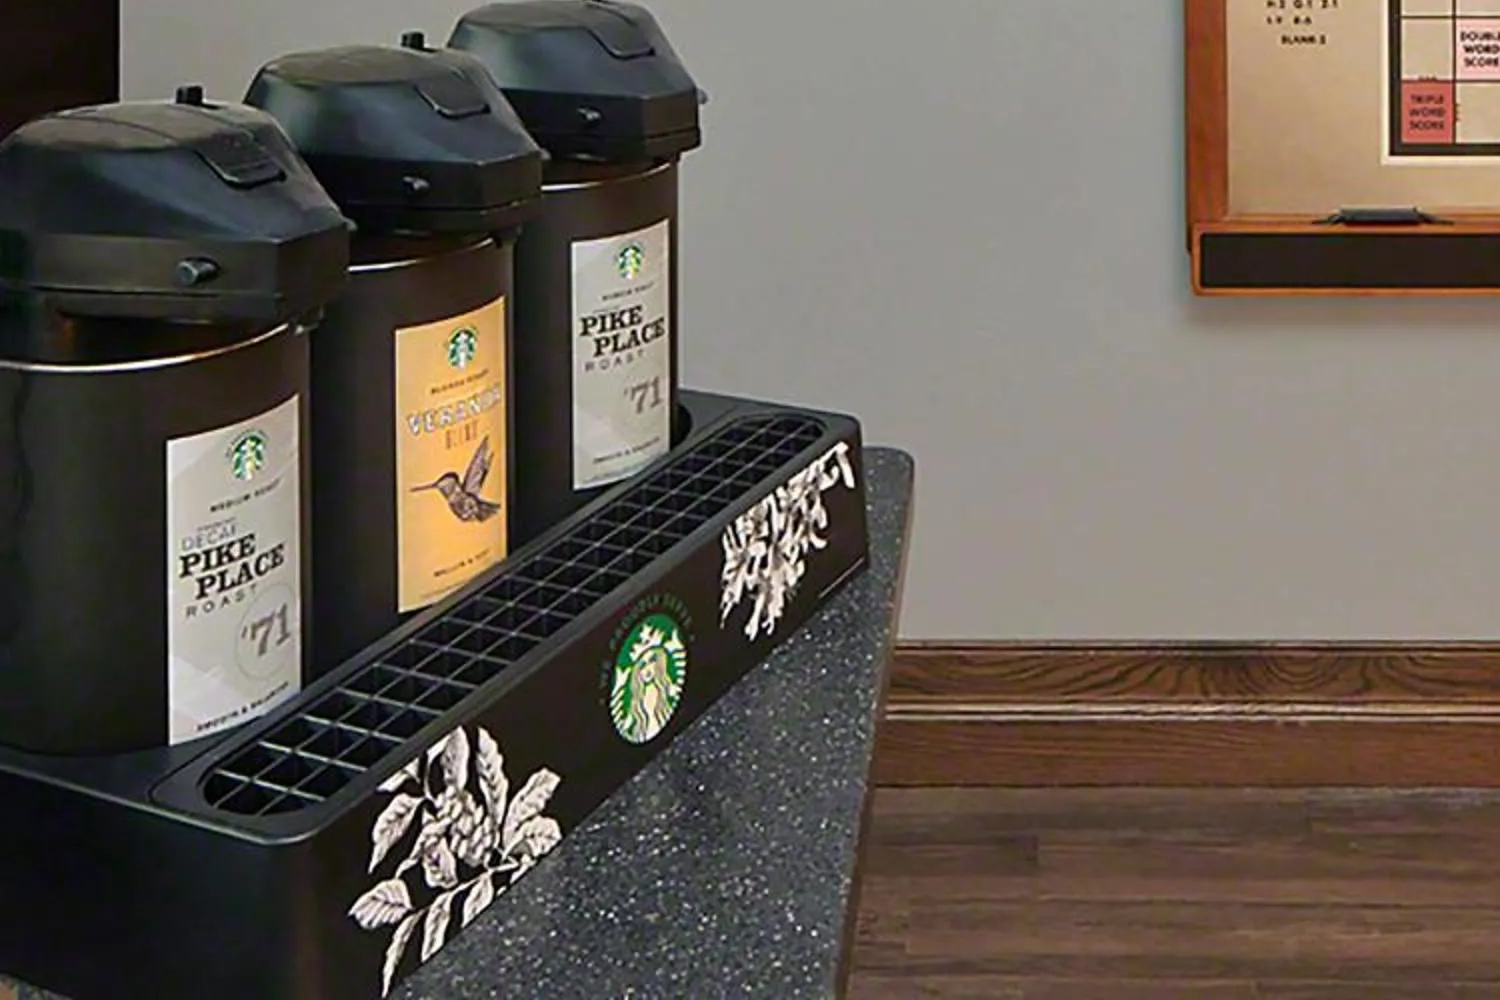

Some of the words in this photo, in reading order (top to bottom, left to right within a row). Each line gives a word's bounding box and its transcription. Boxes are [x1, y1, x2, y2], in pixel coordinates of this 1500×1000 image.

[1462, 43, 1500, 55] WORD
[1463, 56, 1500, 68] SCORE
[579, 304, 642, 337] PIKE
[592, 315, 665, 358] PLACE
[178, 532, 256, 579] PIKE
[194, 541, 285, 600] PLACE
[185, 583, 257, 618] ROAST
